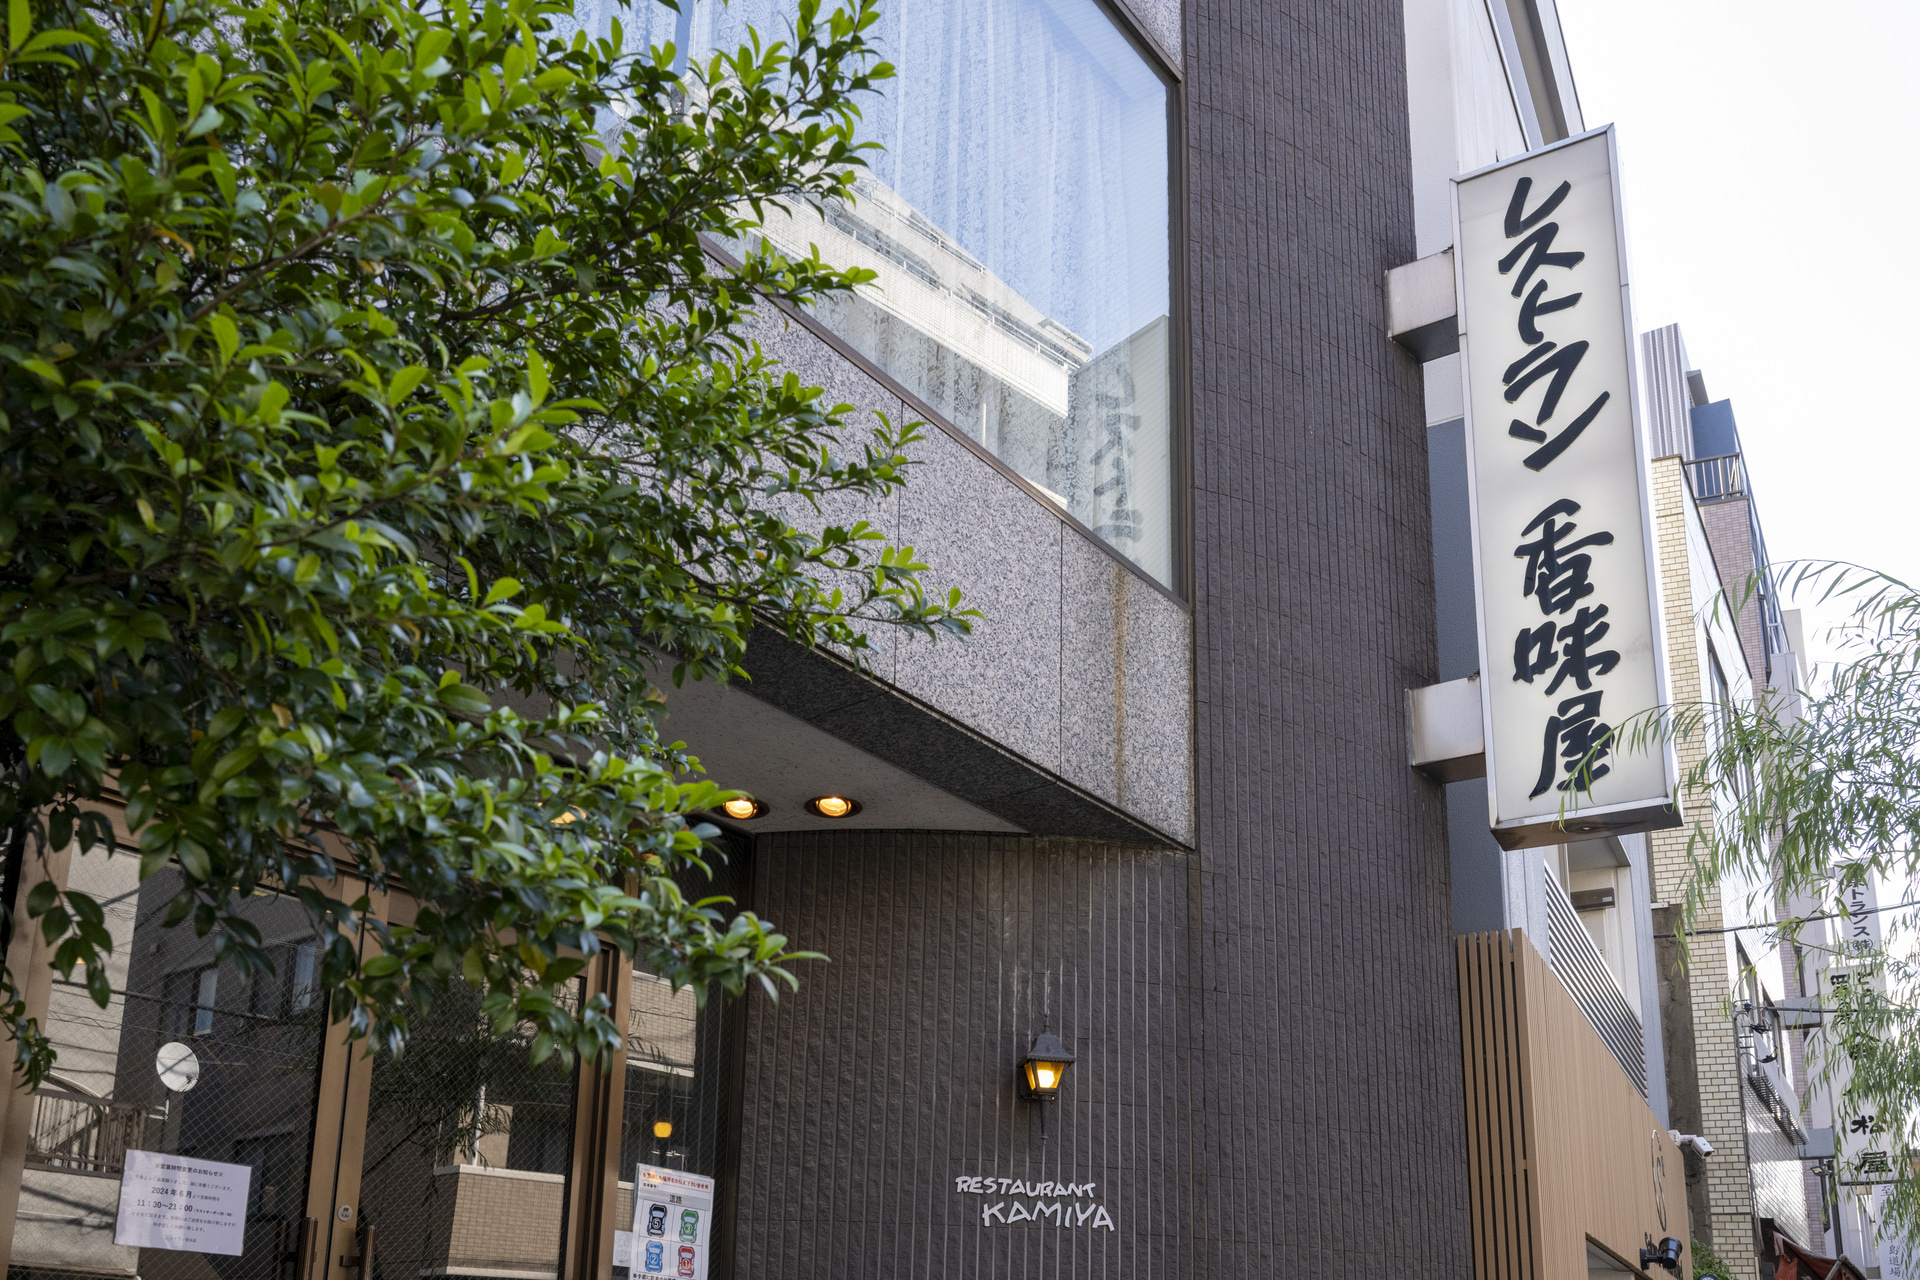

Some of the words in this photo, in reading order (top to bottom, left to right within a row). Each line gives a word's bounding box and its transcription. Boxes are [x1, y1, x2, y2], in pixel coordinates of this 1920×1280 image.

[1498, 176, 1612, 473] レストラン
[1511, 497, 1622, 801] 香味屋
[669, 1194, 683, 1205] 道路
[955, 1176, 1096, 1198] RESTAURANT
[982, 1200, 1115, 1232] KAMIYA
